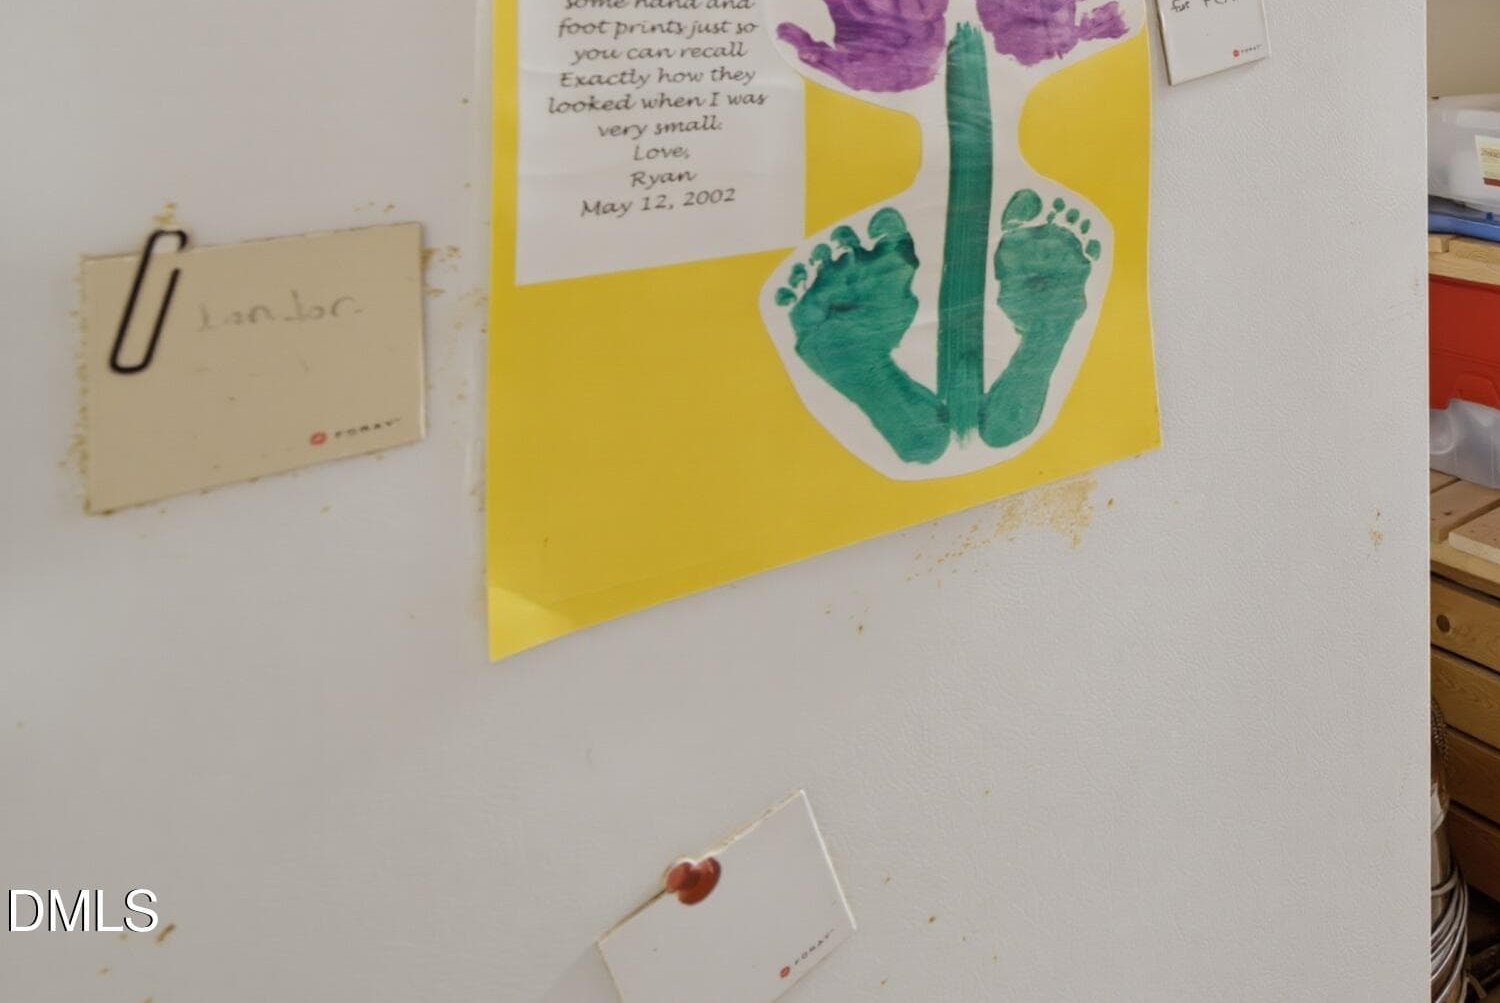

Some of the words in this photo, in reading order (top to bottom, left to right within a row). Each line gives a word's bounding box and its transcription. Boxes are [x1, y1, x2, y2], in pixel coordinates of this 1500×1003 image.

[558, 18, 610, 38] foot
[613, 20, 687, 39] prints
[689, 19, 731, 39] just
[735, 23, 758, 35] so
[570, 48, 622, 65] you
[626, 48, 674, 61] can
[679, 41, 748, 59] recall
[559, 68, 651, 89] Exactly
[657, 68, 704, 83] how
[711, 66, 756, 84] they
[548, 95, 636, 114] looked
[640, 95, 705, 110] when
[709, 92, 719, 107] I
[726, 93, 768, 106] was
[597, 122, 648, 140] very
[630, 169, 698, 190] Ryan
[580, 199, 633, 218] May
[683, 188, 736, 206] 2002
